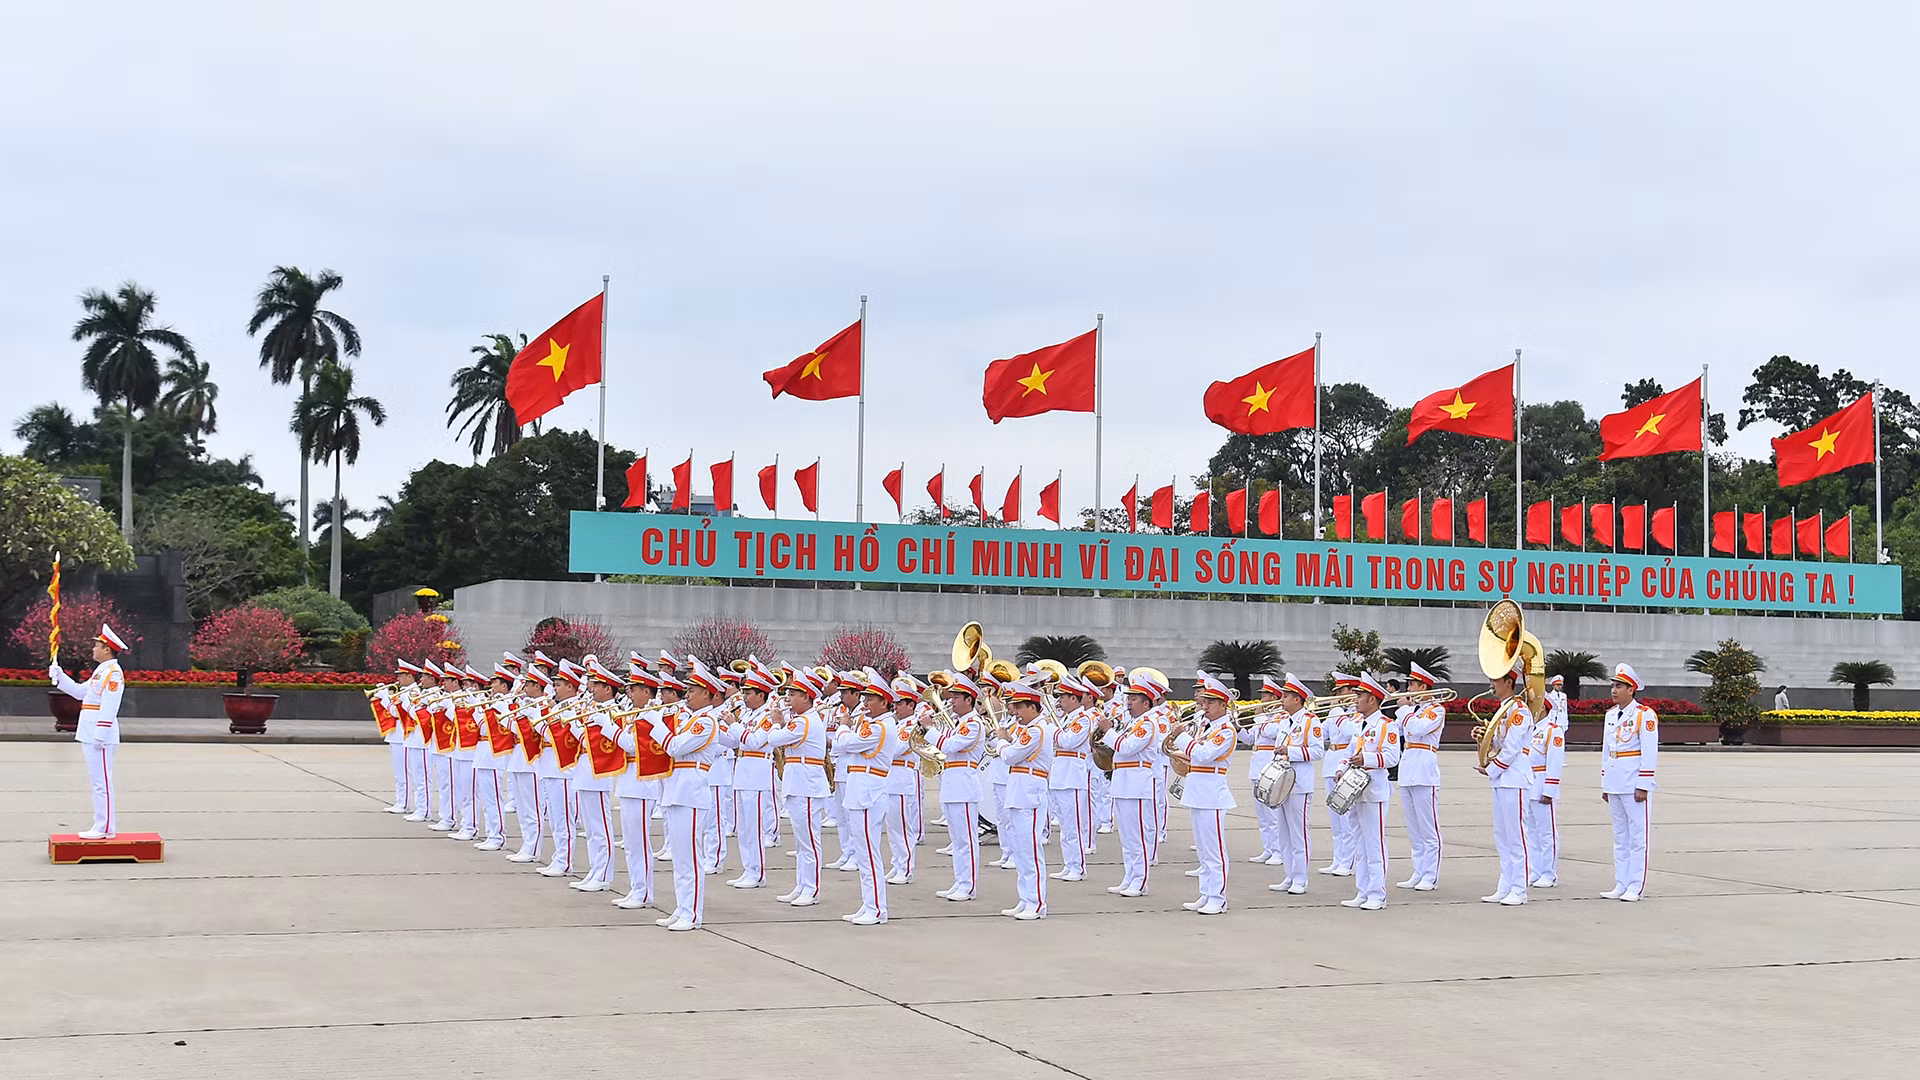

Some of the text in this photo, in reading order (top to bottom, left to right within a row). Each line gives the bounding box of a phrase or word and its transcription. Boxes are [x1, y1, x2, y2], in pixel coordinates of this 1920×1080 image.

[642, 519, 1856, 604] CHỦ TỊCH HỒ CHÍ MINH VĨ ĐẠI SỐNG MÃI TRONG SỰ NGHIỆP CỦA CHÚNG TA !
